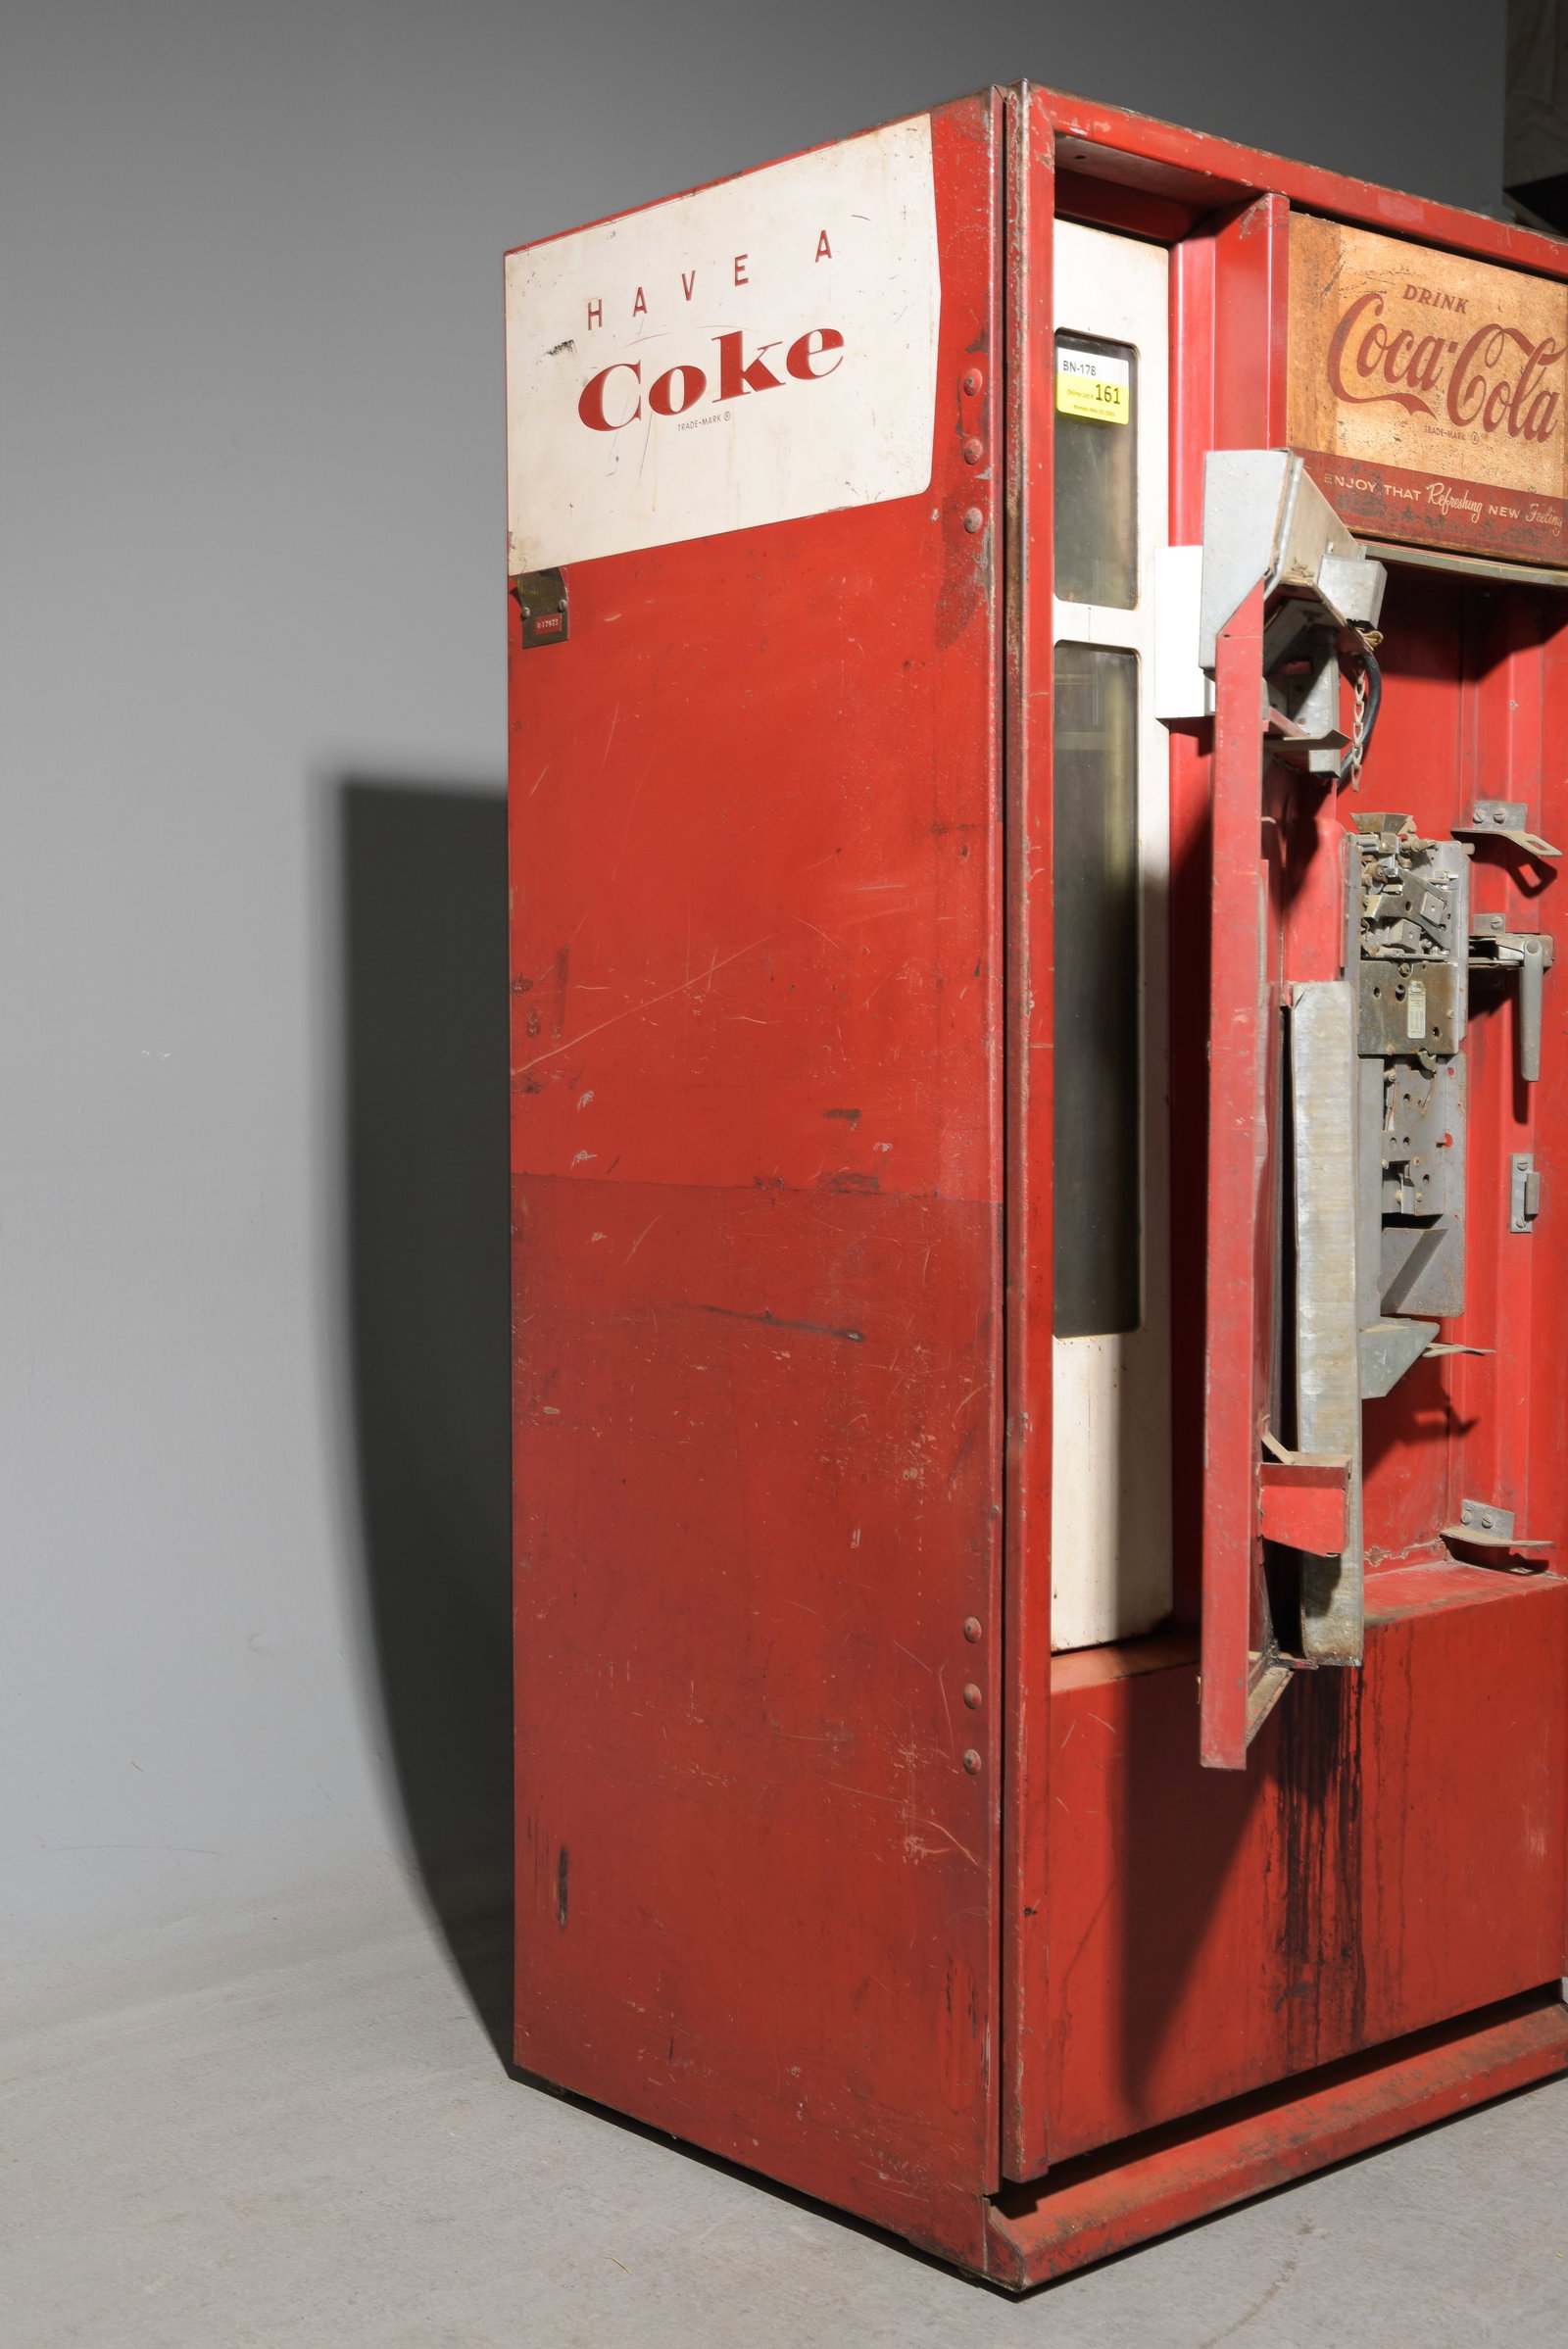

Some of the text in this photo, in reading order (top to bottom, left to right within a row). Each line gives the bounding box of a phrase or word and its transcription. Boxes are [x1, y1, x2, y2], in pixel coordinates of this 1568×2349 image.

[588, 230, 833, 330] HAVE A
[1402, 284, 1469, 315] DRINK
[578, 327, 845, 431] Coke
[1063, 360, 1097, 376] BN-178
[1327, 293, 1568, 444] Coca-Cola
[1096, 384, 1120, 405] 161
[678, 415, 721, 431] TRADE-MARK
[1424, 424, 1465, 441] TRADE-MARK
[1324, 473, 1378, 493] ENJOY
[1384, 484, 1422, 501] THAT
[1426, 482, 1483, 523] Refreshing
[1489, 505, 1521, 519] NEW
